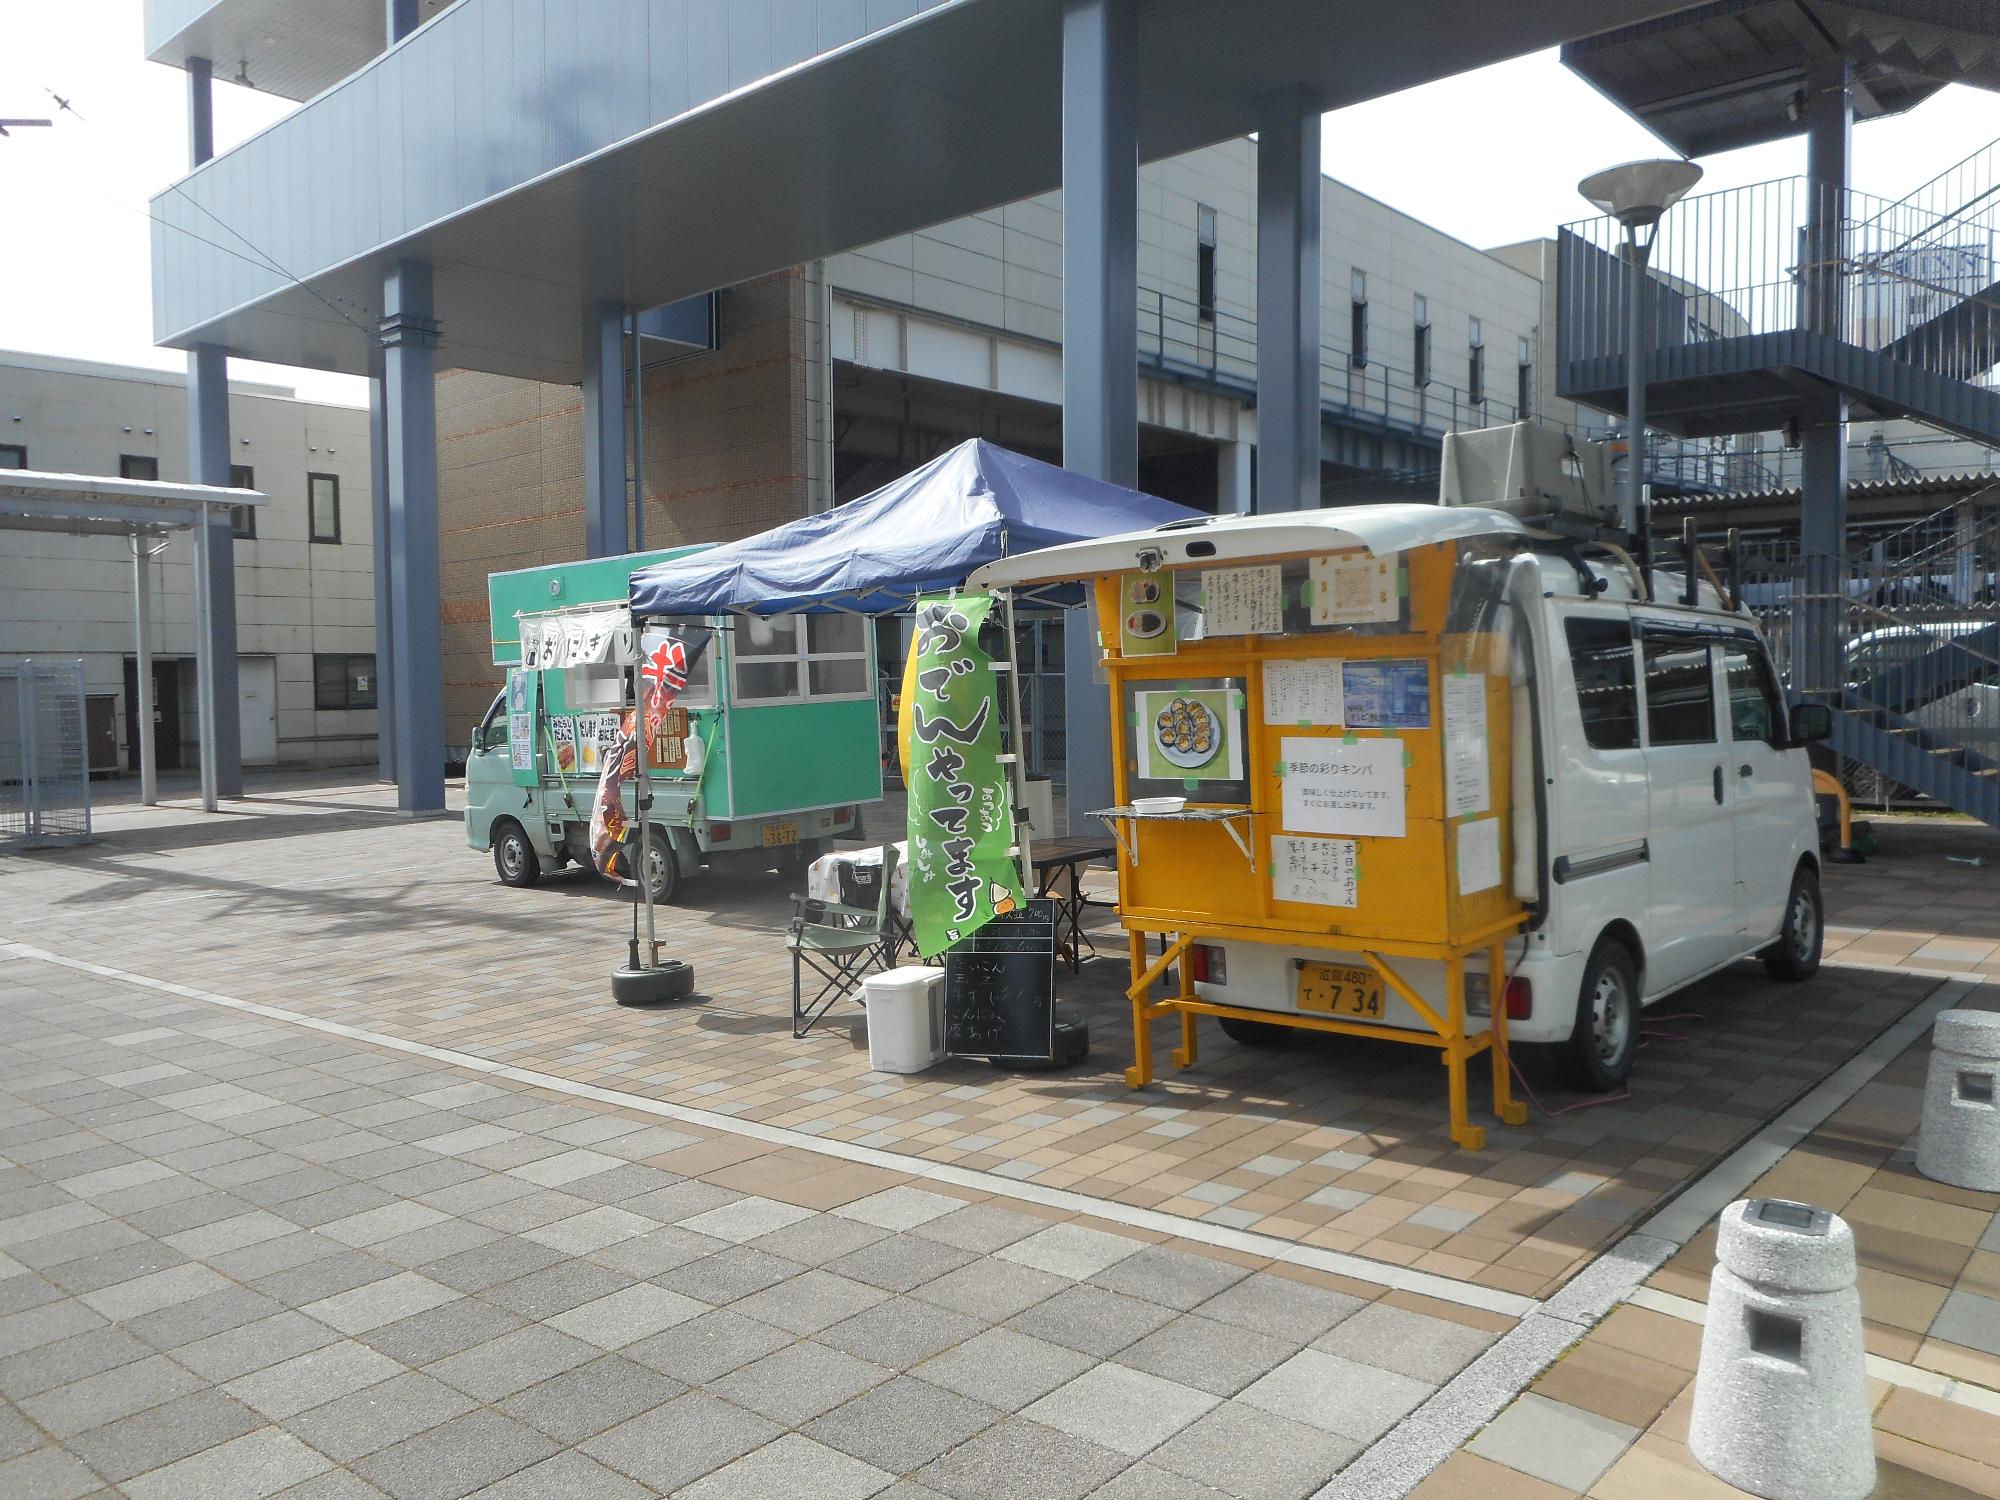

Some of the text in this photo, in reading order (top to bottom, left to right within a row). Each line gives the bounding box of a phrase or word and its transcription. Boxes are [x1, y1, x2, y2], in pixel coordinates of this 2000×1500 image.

[543, 633, 634, 661] おにぎり
[553, 719, 573, 729] みたらし
[914, 601, 991, 923] おでんやってます
[1289, 762, 1374, 776] 季節の彩りキンパ
[915, 834, 936, 883] しみしみ
